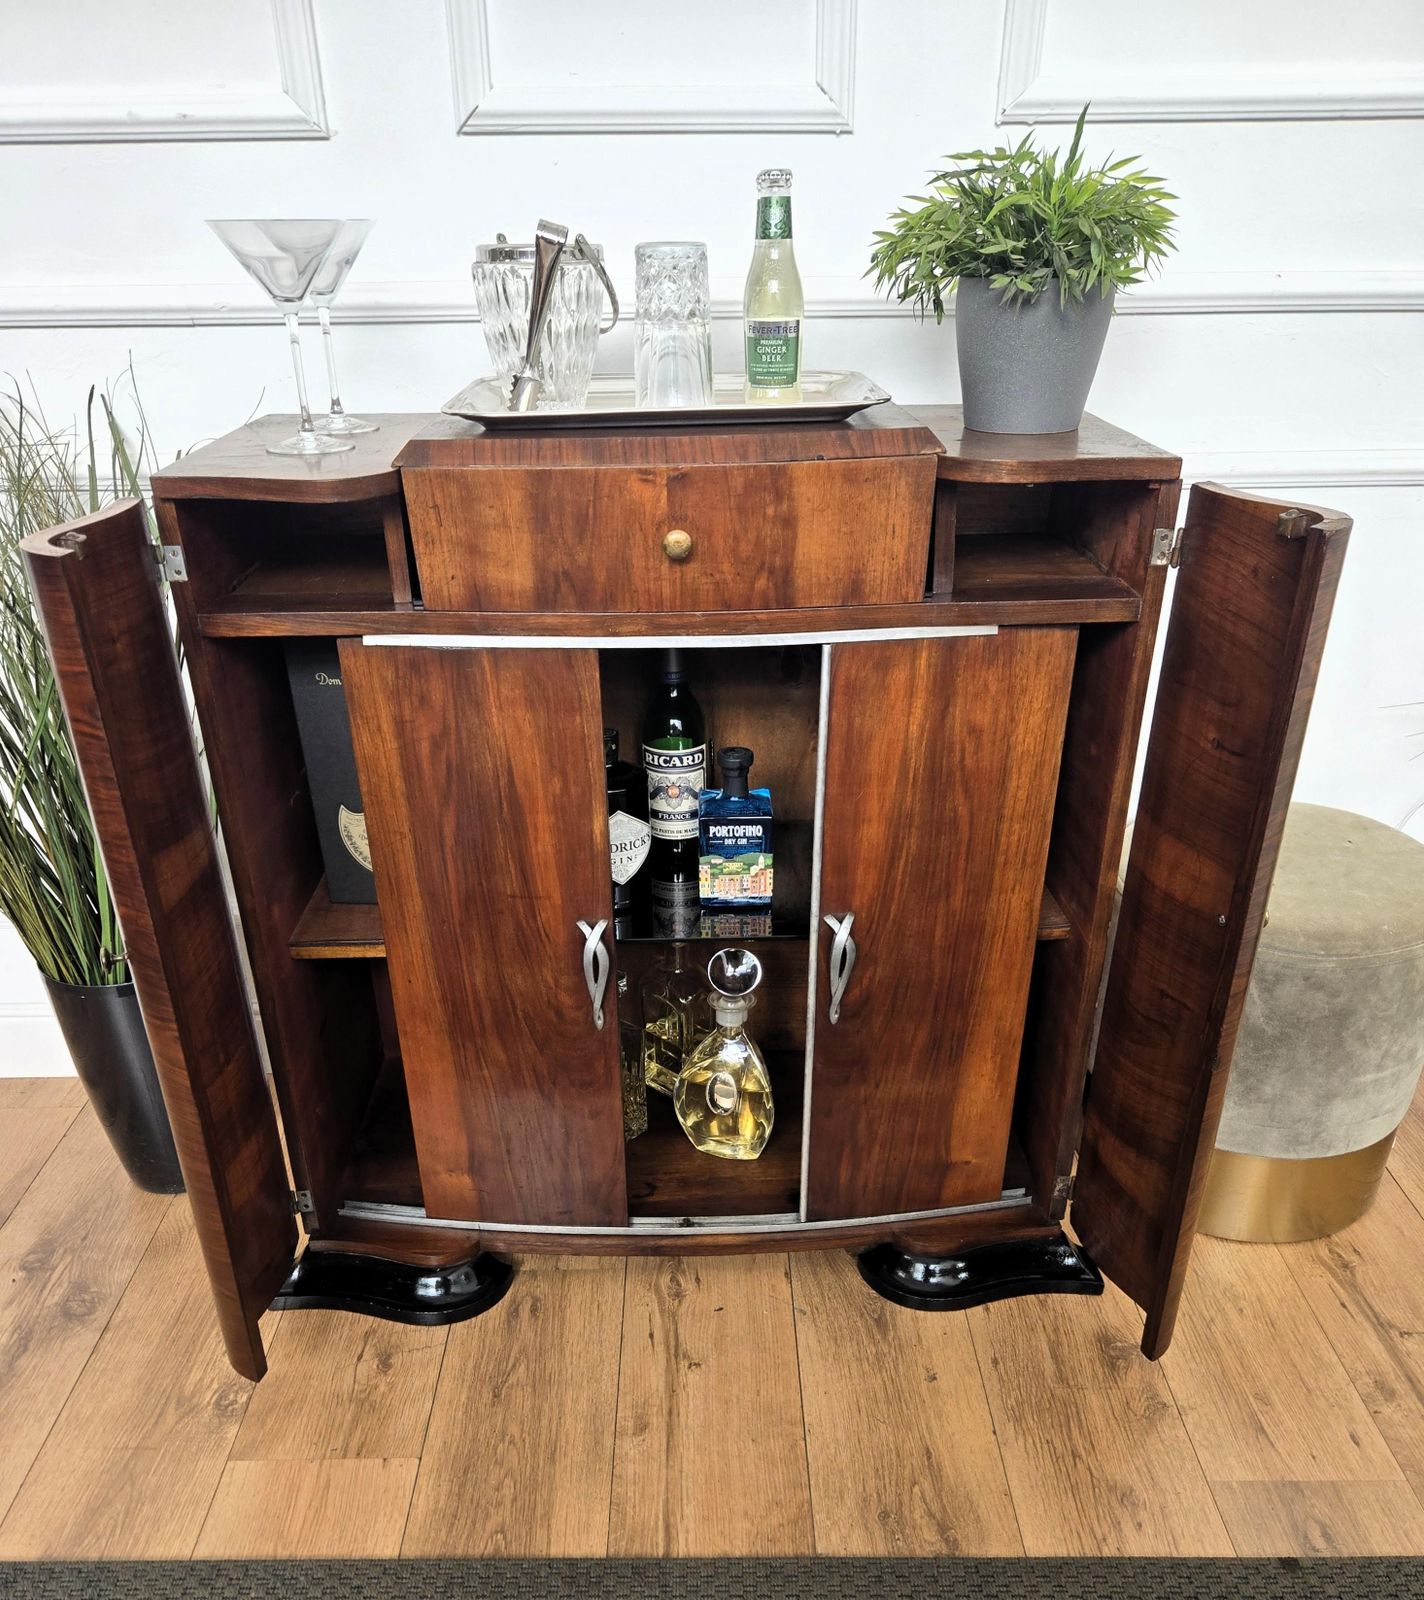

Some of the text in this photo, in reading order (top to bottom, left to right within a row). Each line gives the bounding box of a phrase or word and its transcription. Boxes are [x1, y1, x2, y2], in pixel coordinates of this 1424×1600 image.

[748, 325, 799, 334] FEVER-TREE
[761, 354, 782, 362] BEER
[315, 672, 342, 685] Dom
[645, 751, 703, 767] RICARD
[658, 812, 691, 820] FRANCE
[709, 825, 763, 837] PORTOFINO
